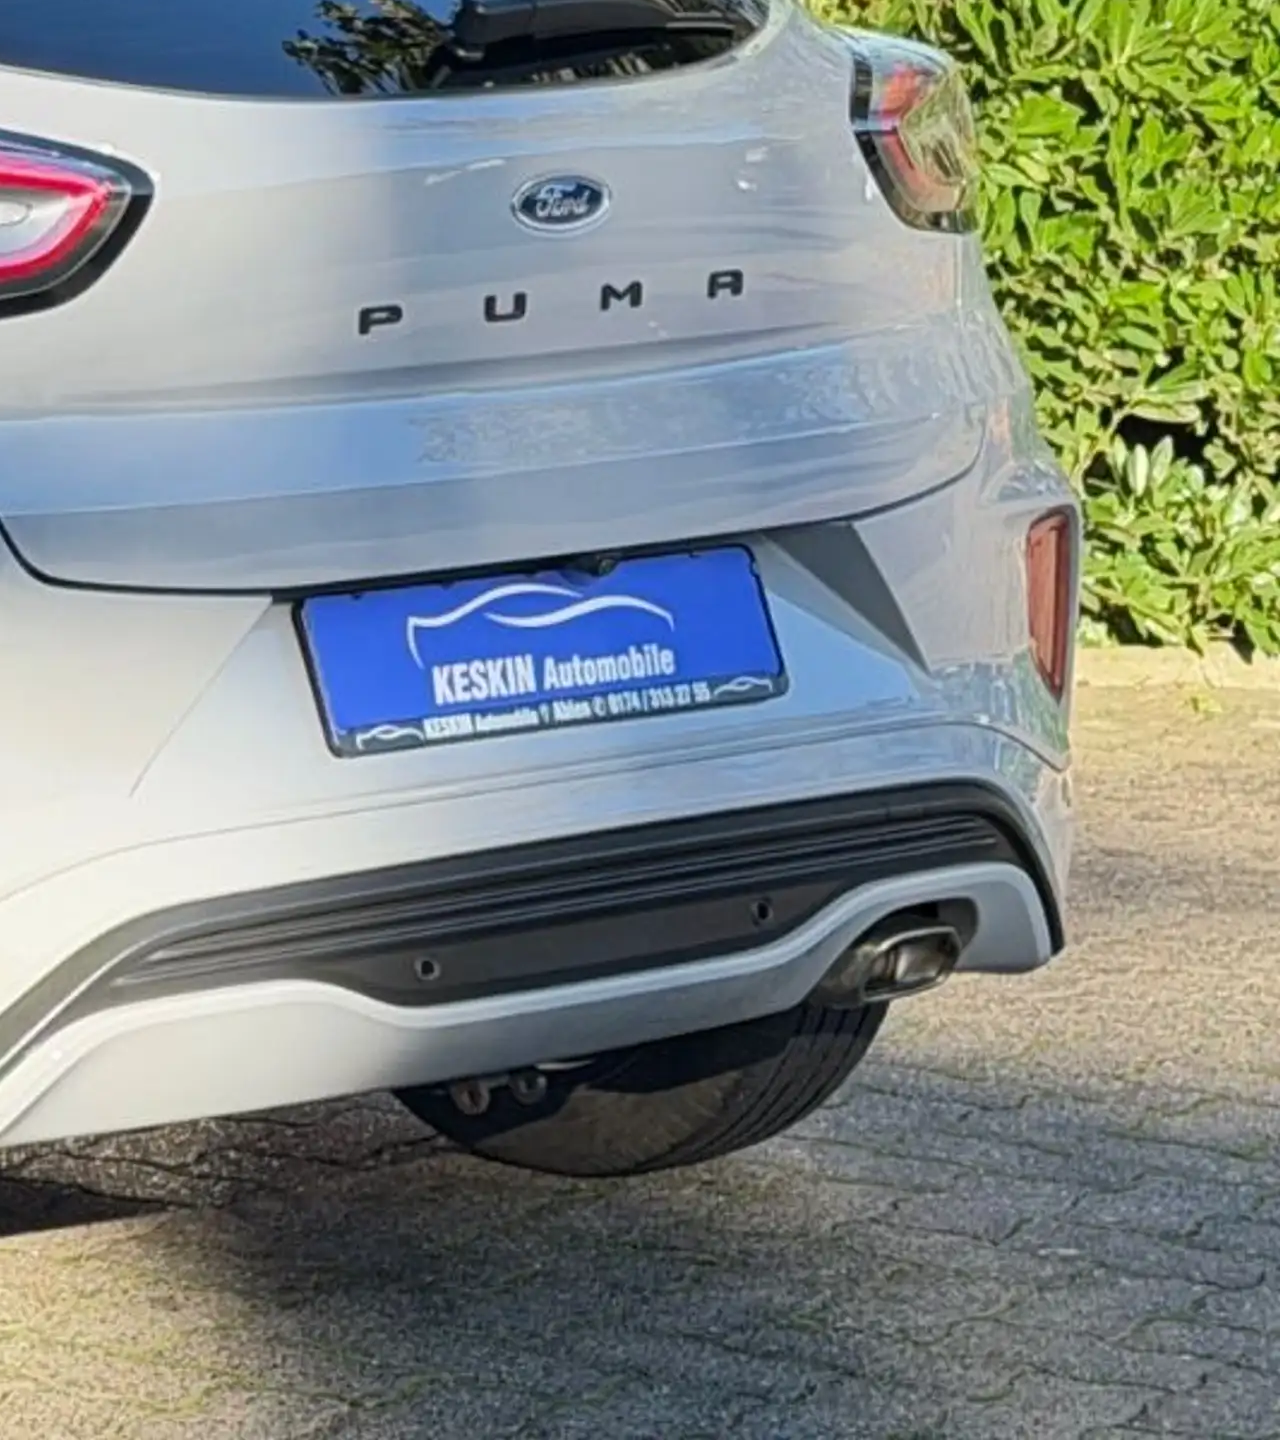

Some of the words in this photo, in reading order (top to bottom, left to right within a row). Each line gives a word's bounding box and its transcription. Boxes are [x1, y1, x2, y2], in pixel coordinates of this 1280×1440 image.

[535, 182, 592, 218] Ford
[357, 268, 745, 336] PUMA
[431, 653, 537, 706] KESKIN
[543, 642, 676, 691] Automobile
